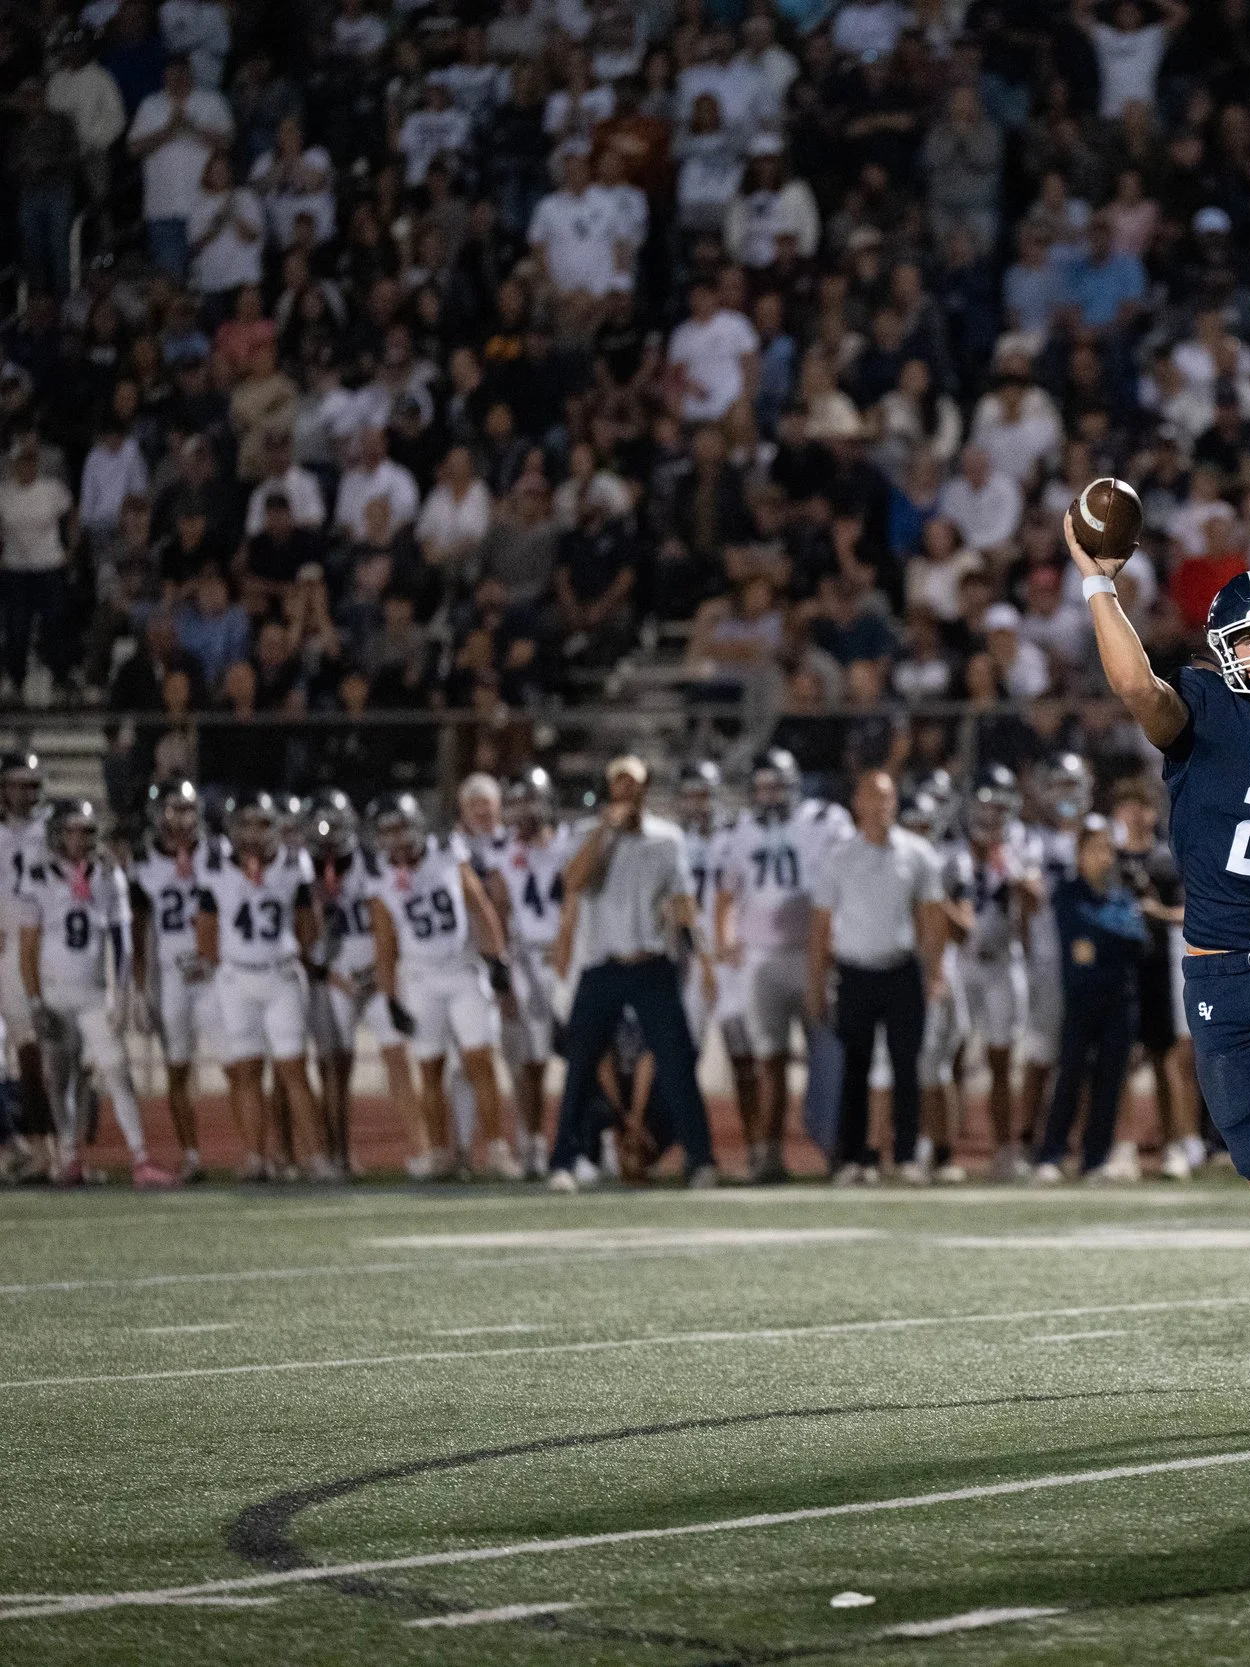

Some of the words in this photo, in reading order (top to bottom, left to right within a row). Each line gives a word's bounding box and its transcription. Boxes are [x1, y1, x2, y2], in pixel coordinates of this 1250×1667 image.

[234, 899, 283, 941] 43
[405, 888, 457, 939] 59
[1198, 1001, 1213, 1020] SV
